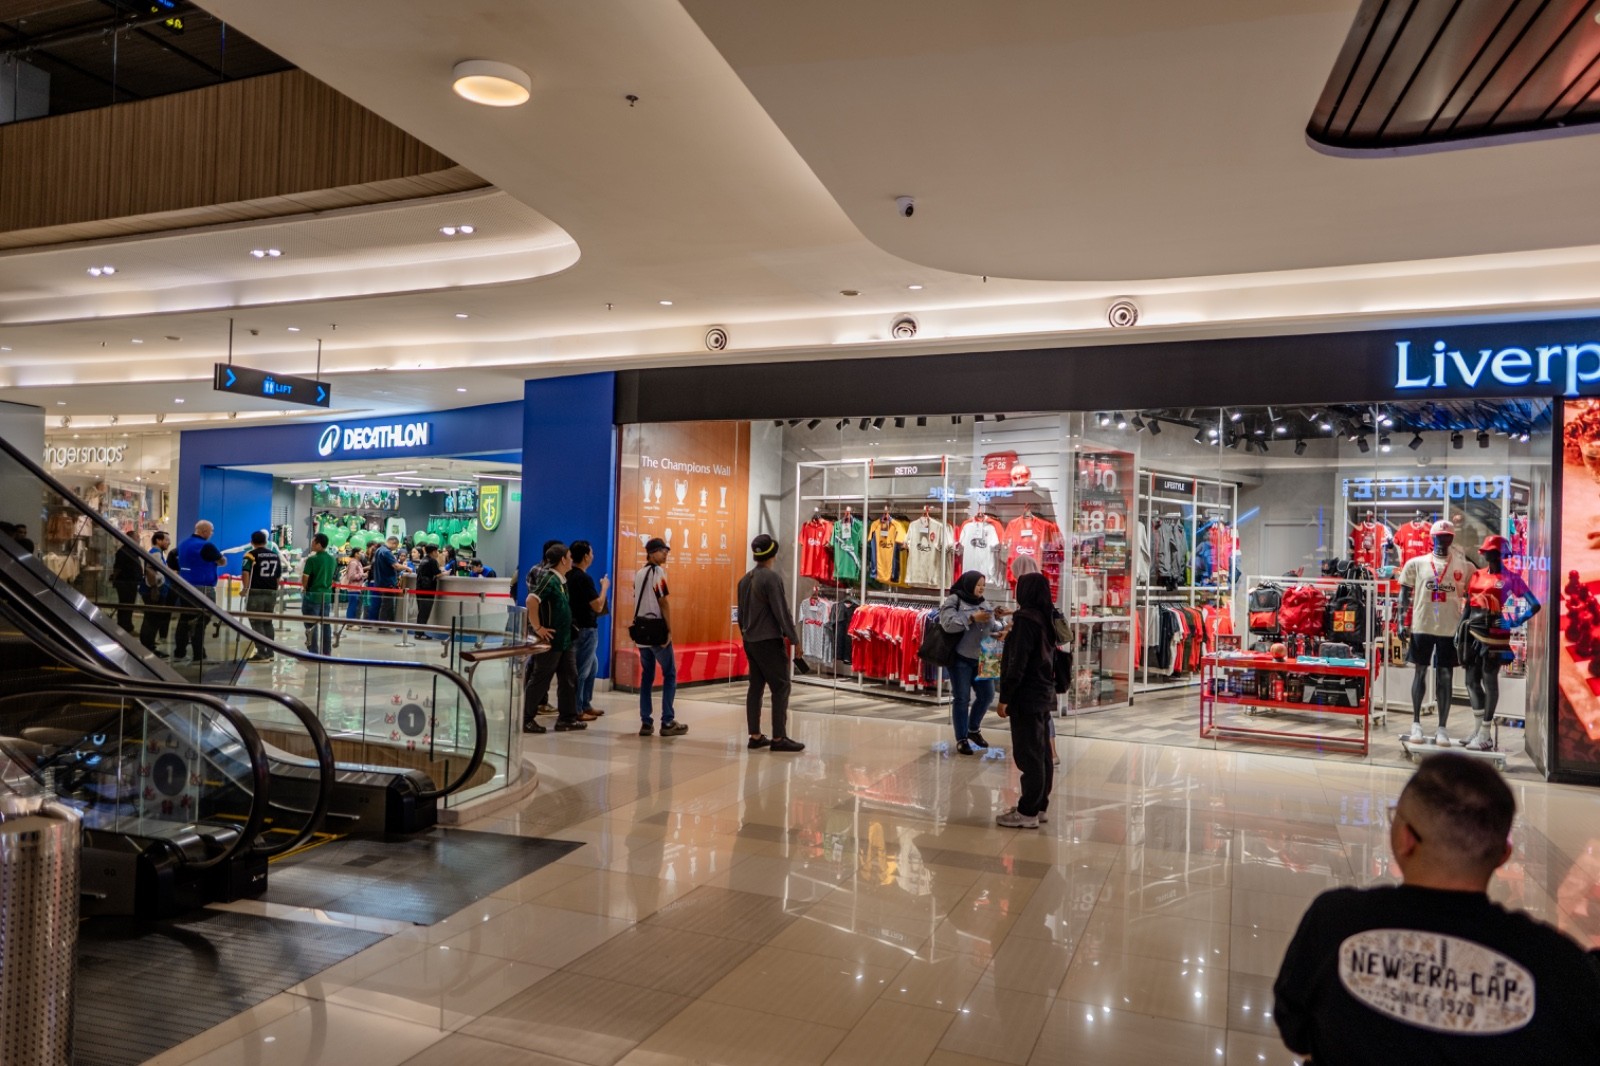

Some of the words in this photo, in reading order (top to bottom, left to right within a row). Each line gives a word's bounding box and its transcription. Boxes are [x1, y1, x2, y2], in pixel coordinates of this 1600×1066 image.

[1394, 341, 1600, 396] Liverp
[275, 384, 293, 395] LIFT
[343, 422, 429, 450] DECATHLON
[43, 443, 124, 467] ingersnaps
[641, 455, 659, 468] The
[660, 457, 711, 475] Champions
[713, 464, 731, 476] Wall
[894, 466, 918, 476] RETRO
[1164, 481, 1185, 491] LIFESTYLE
[259, 560, 278, 577] 27
[408, 713, 415, 728] 1
[166, 765, 173, 784] 1
[1351, 949, 1401, 980] NEW
[1413, 962, 1459, 992] ERA
[1470, 971, 1518, 1003] CAP
[1390, 987, 1431, 1009] SINCE
[1440, 998, 1476, 1019] 1920
